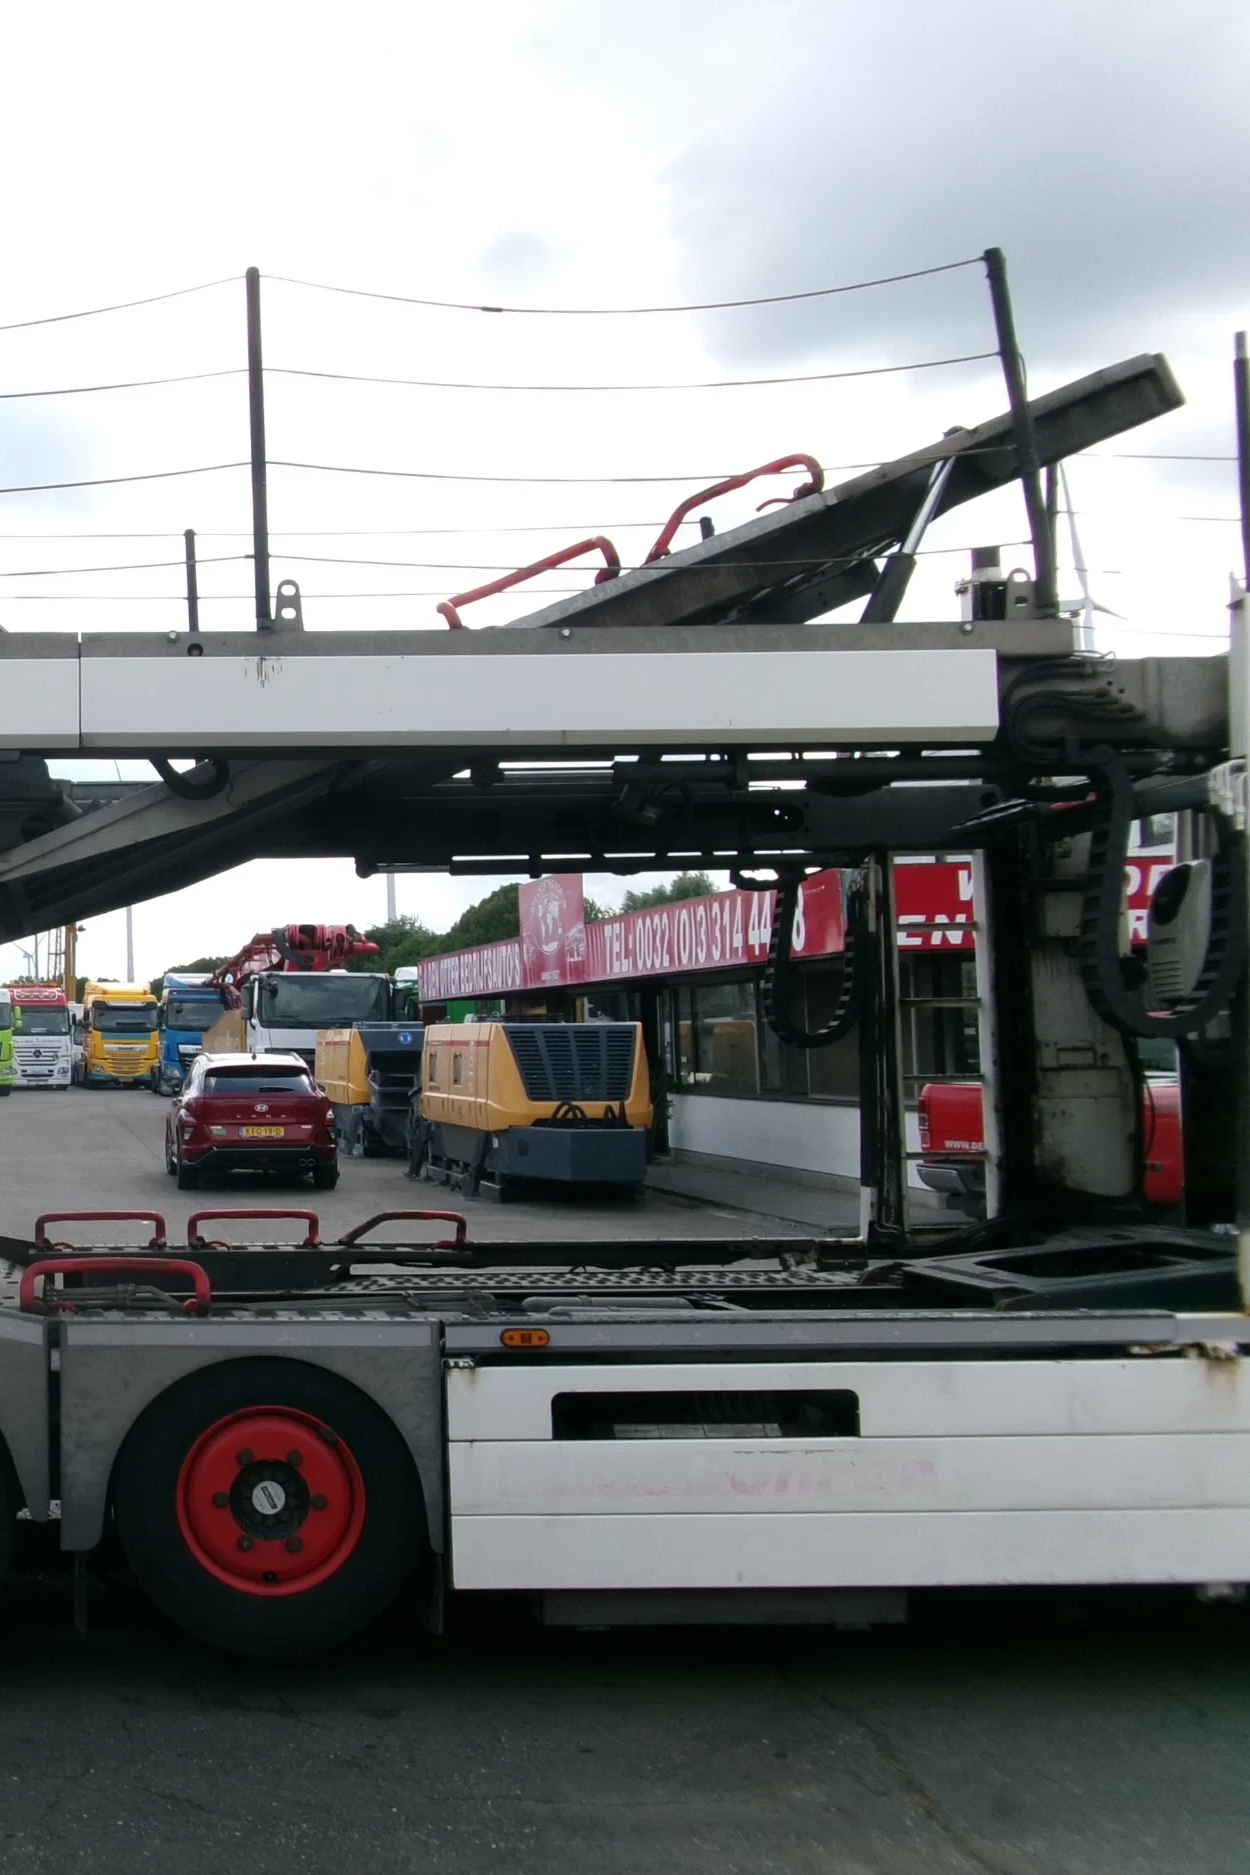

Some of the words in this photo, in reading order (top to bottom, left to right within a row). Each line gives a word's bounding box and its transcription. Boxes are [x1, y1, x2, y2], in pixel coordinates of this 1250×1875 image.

[604, 922, 633, 974] TEL:
[636, 912, 670, 971] 0032
[674, 904, 707, 967] (0)3
[712, 896, 743, 961] 314
